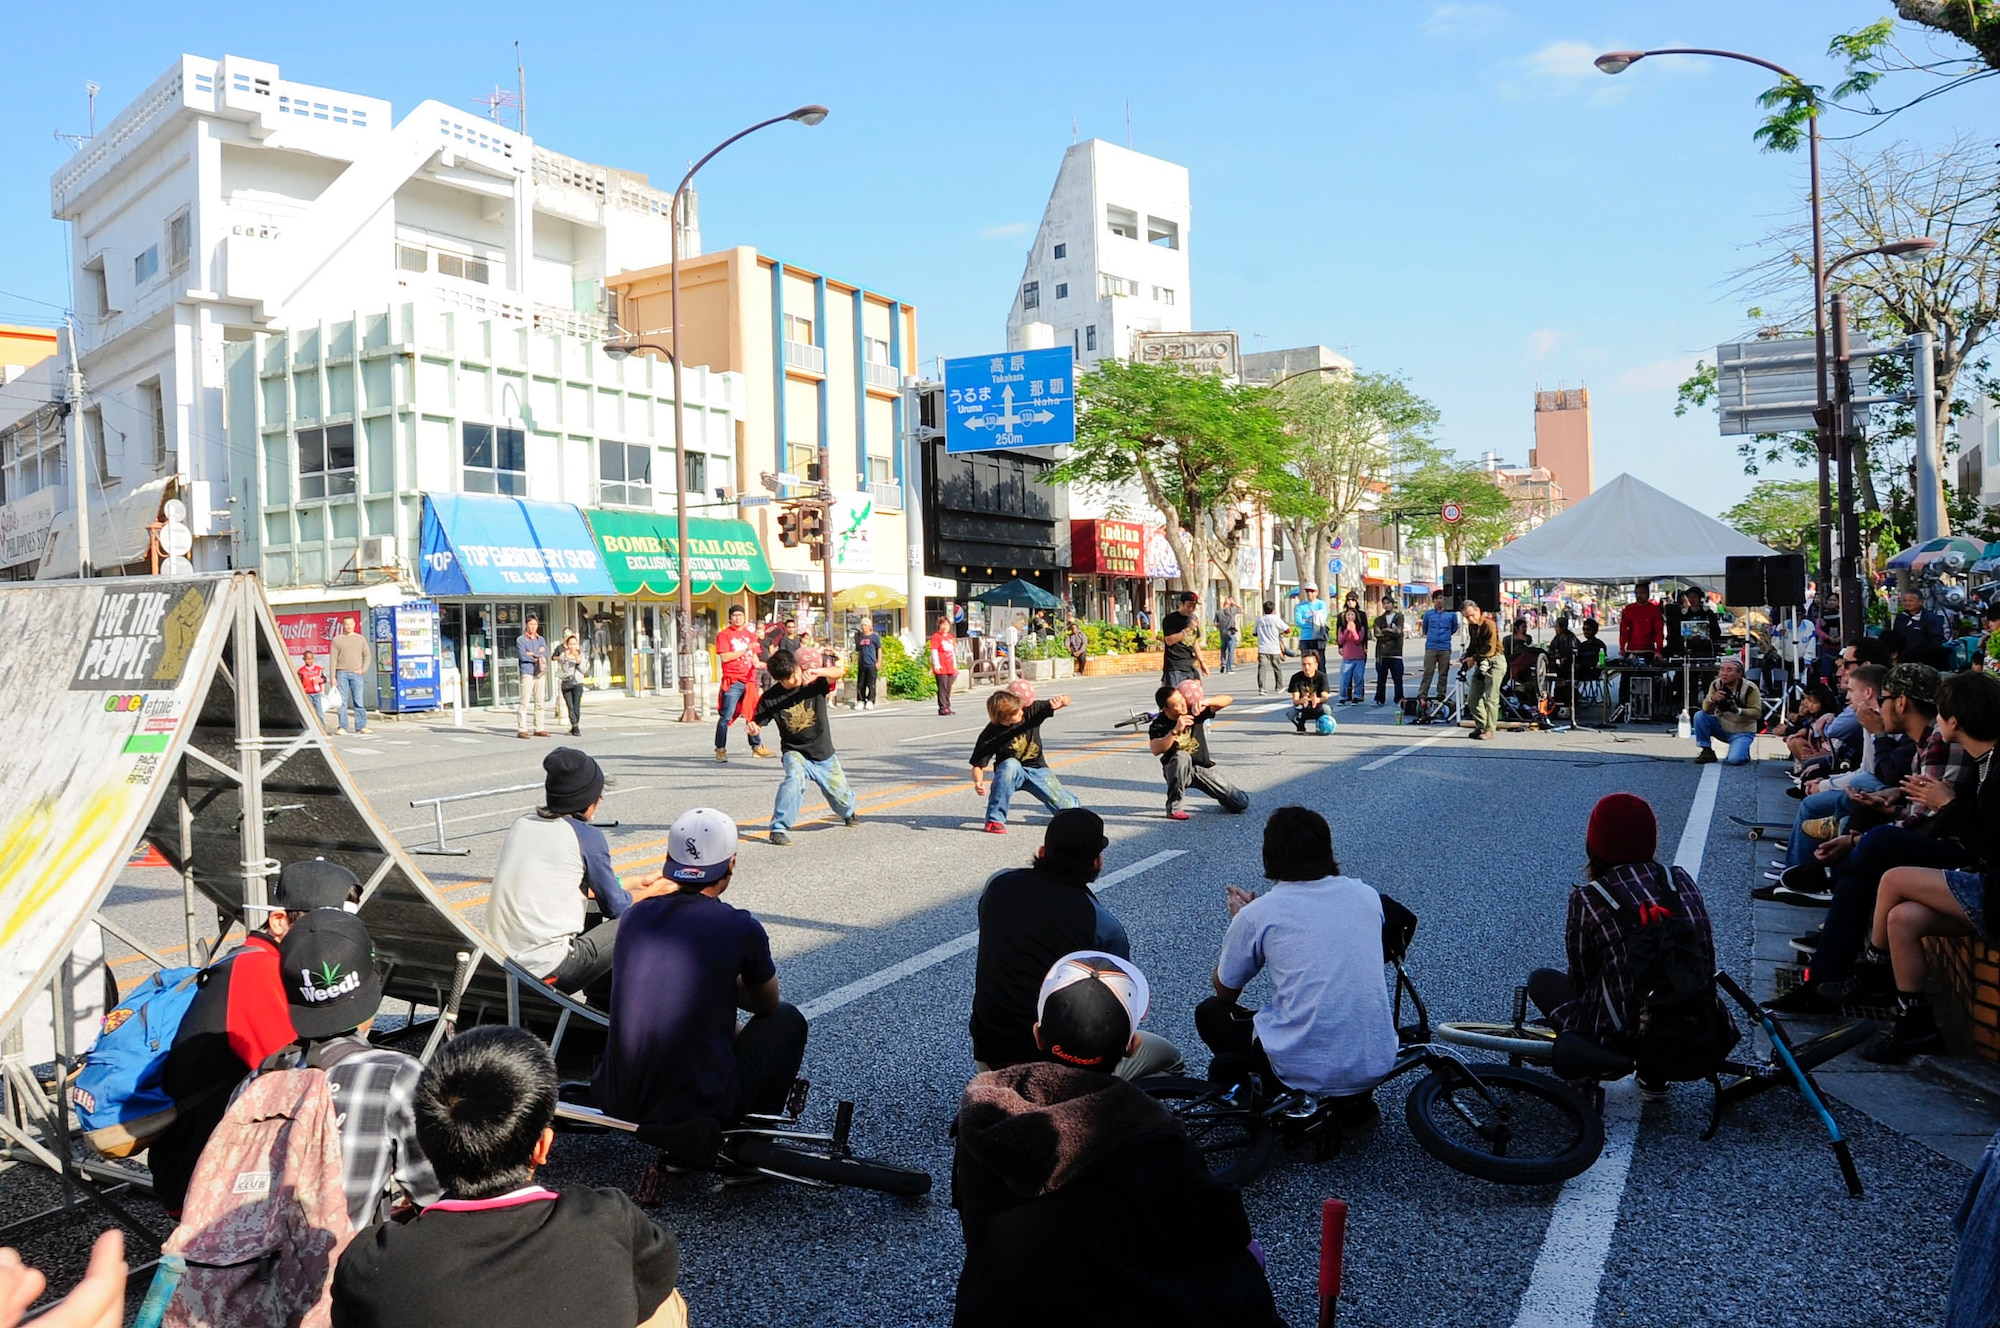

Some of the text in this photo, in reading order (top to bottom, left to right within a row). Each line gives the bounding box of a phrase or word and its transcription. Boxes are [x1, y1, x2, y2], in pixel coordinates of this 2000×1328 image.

[1143, 341, 1230, 360] SEIKO
[990, 355, 1025, 374] 高原
[992, 374, 1024, 384] Takahara
[1030, 378, 1064, 397] 那覇
[949, 386, 992, 404] うるま
[1034, 397, 1060, 407] Naha
[957, 404, 983, 414] Uruma
[995, 432, 1023, 445] 250m
[1447, 508, 1457, 517] 40
[1100, 523, 1140, 543] Indian
[602, 535, 758, 556] BOMBAY TAILORS
[1101, 542, 1139, 560] Tailor
[424, 552, 453, 572] TOP
[459, 545, 489, 567] TOP
[563, 549, 598, 570] SHOP
[625, 556, 751, 572] EXCLUSIVE USTOM TAILORS
[501, 571, 526, 583] TEL
[95, 592, 171, 637] WE THE
[78, 635, 159, 680] PEOPLE
[299, 971, 360, 1002] Weed!
[301, 969, 312, 986] I
